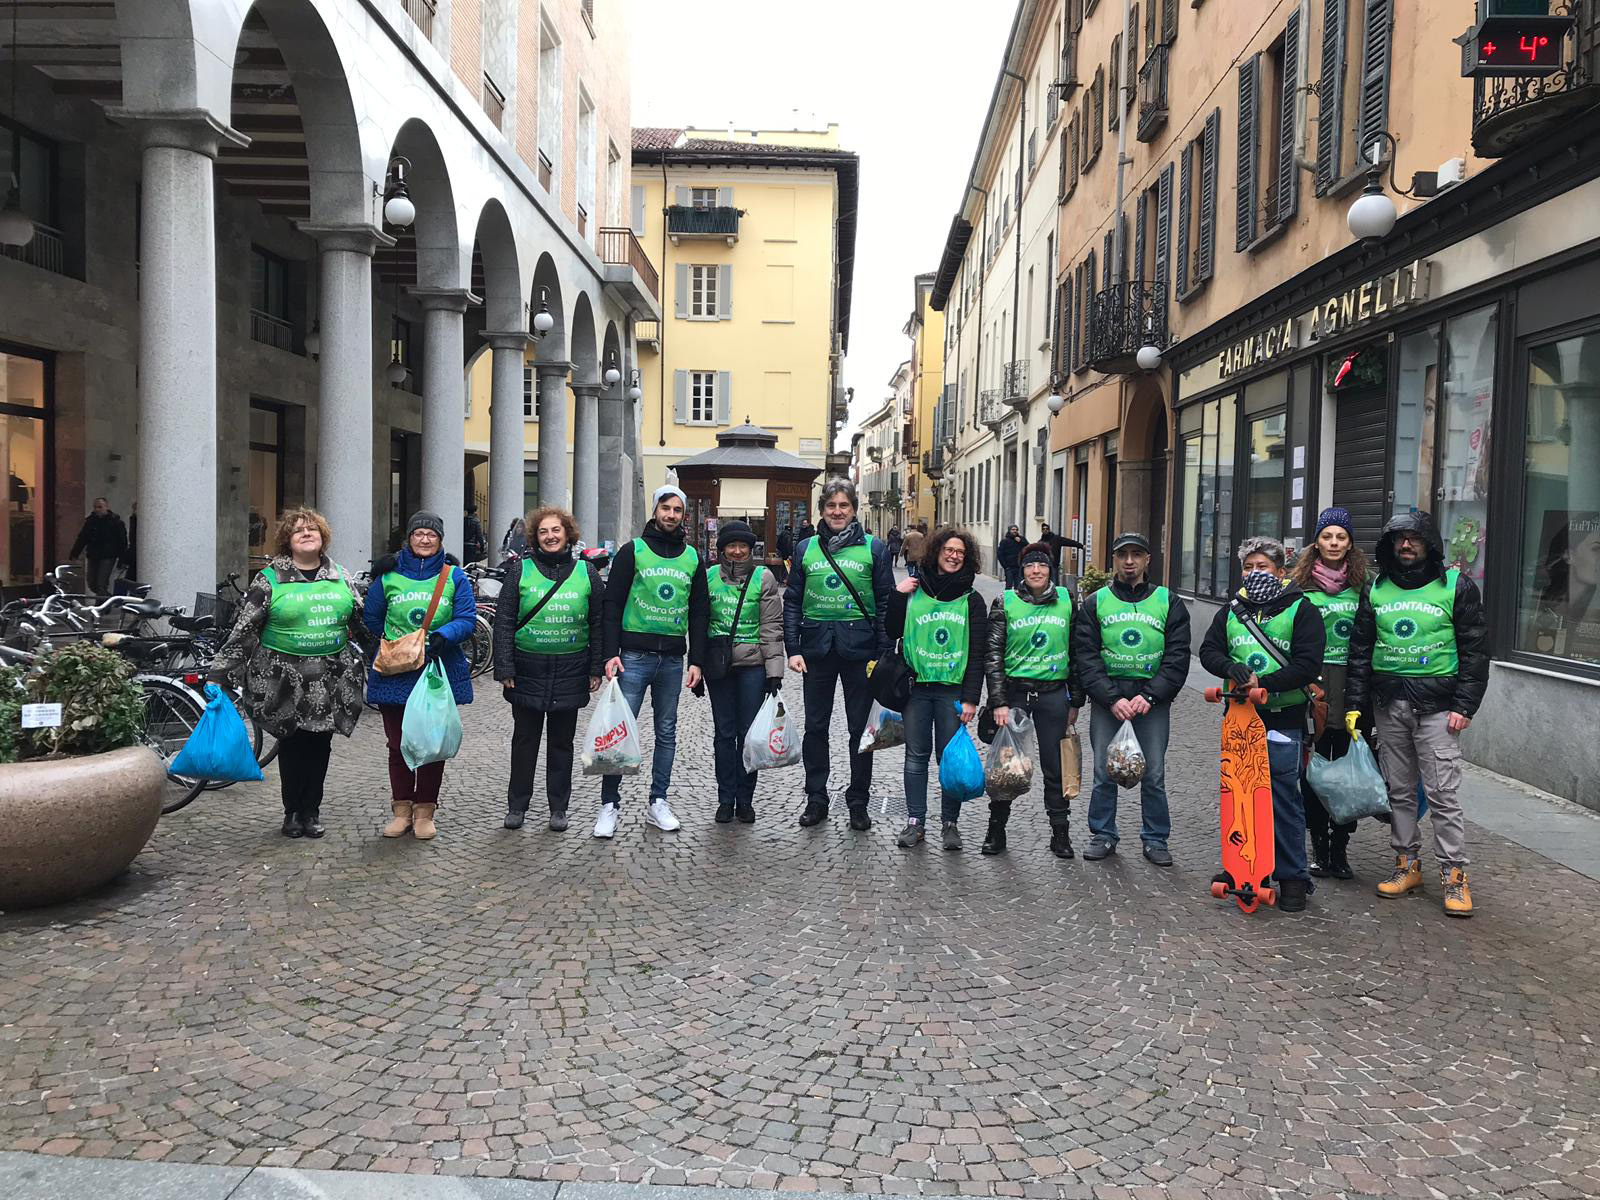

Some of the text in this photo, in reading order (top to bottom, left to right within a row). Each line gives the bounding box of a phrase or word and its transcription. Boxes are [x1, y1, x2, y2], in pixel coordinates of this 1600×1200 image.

[1217, 259, 1422, 379] FARMACIA AGNELLI
[808, 560, 865, 572] VOLOTARIO
[307, 591, 342, 601] verde
[552, 591, 579, 599] erde
[807, 589, 865, 602] Novara Gren
[310, 604, 333, 613] che
[547, 603, 570, 611] che
[634, 597, 668, 614] Novara
[1374, 601, 1443, 617] VOLONTARIO
[916, 612, 966, 626] VOLONTARI
[1010, 616, 1066, 630] VOLONTARIO
[1102, 612, 1161, 628] VOLONTARIO
[529, 628, 559, 636] Novara
[916, 646, 942, 659] Novara
[1409, 641, 1445, 653] Green
[1043, 650, 1067, 662] Green
[1136, 650, 1164, 661] Green
